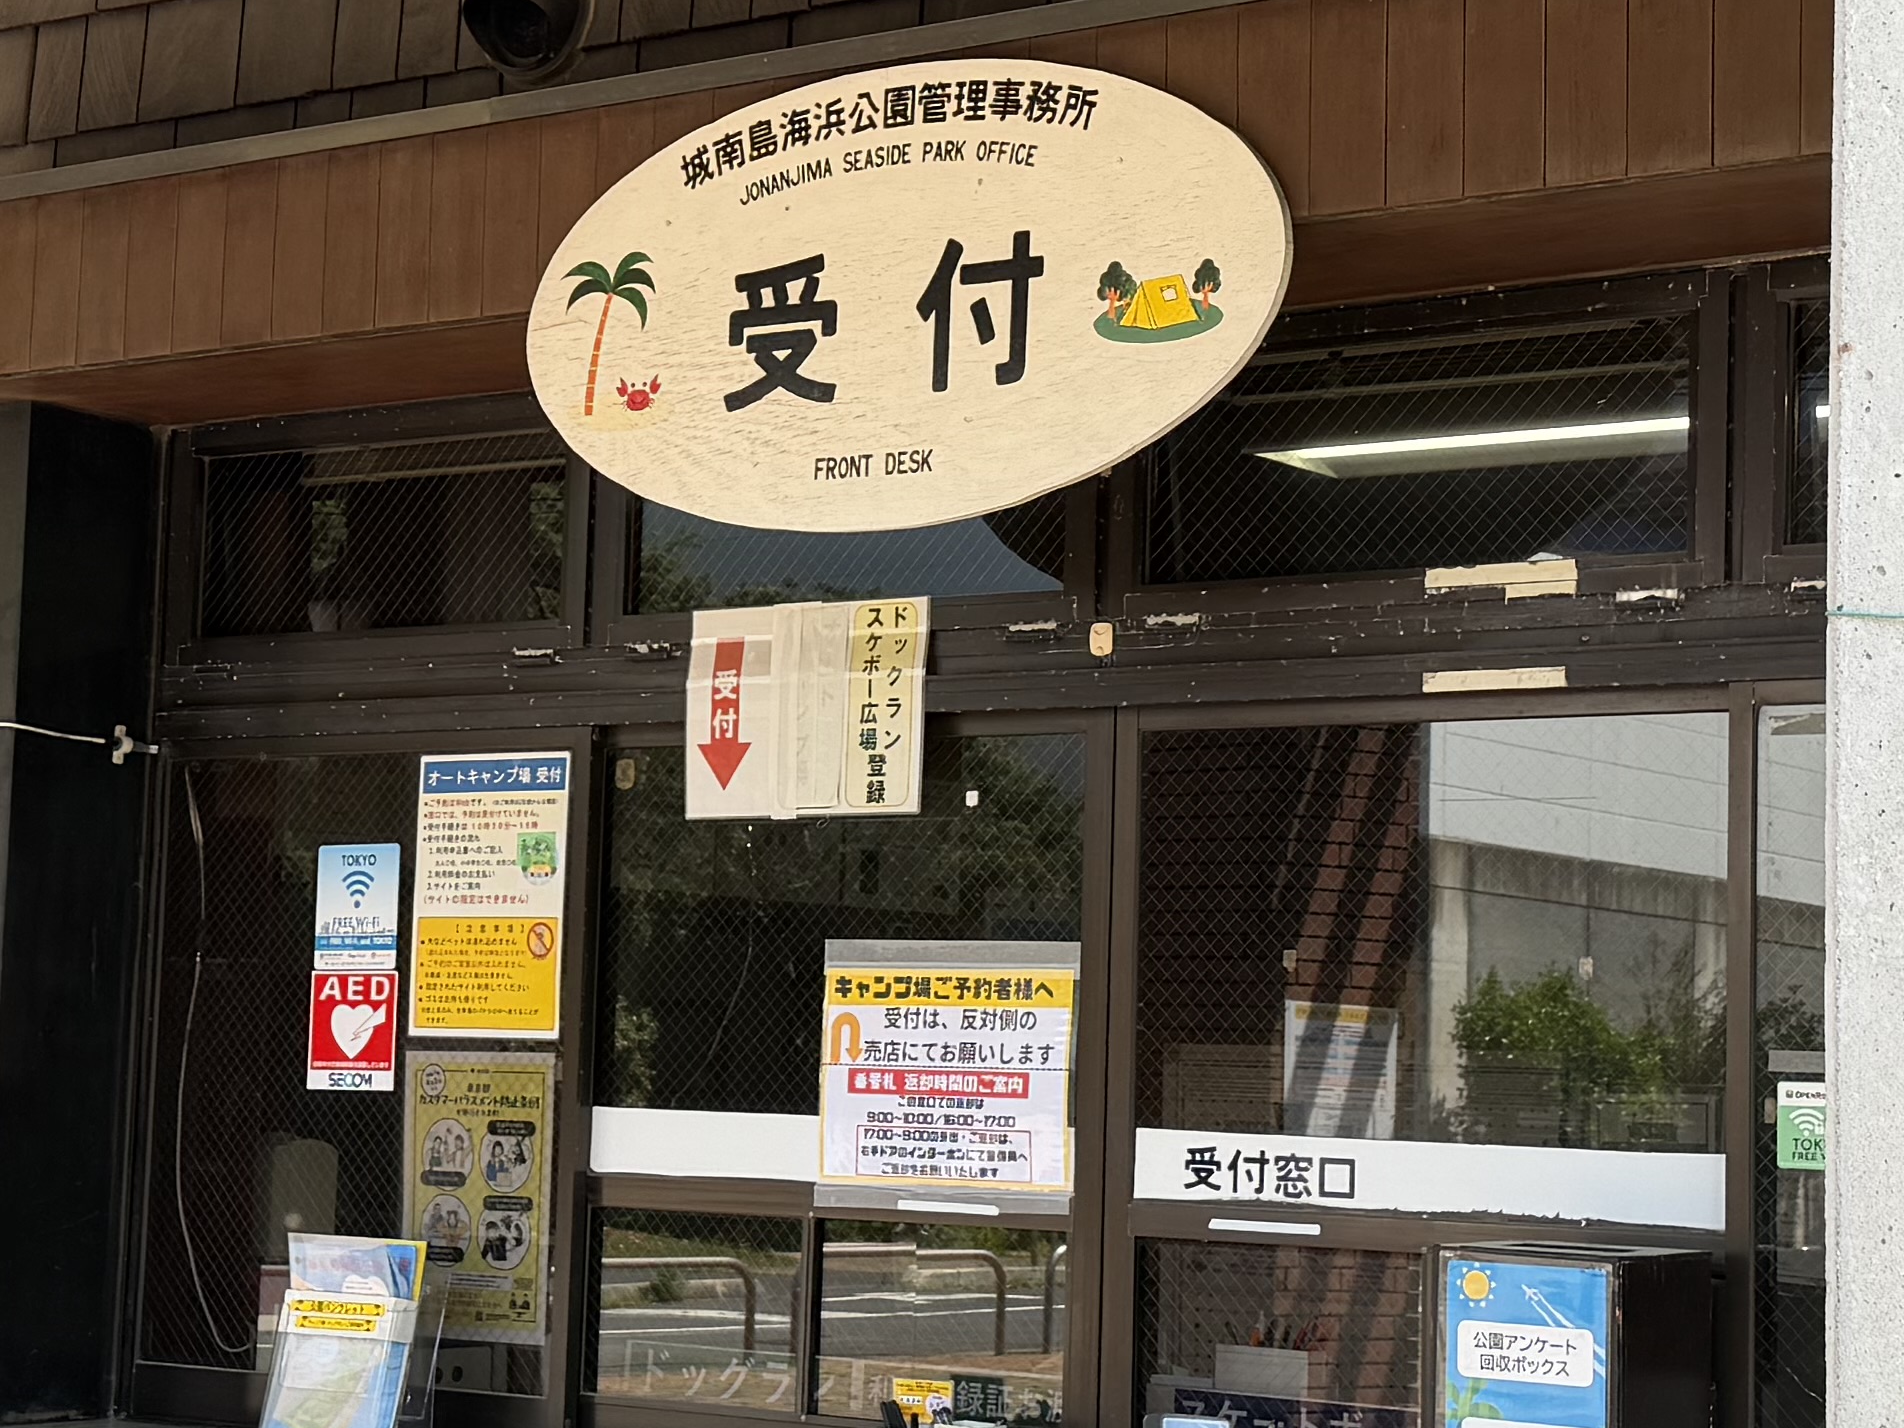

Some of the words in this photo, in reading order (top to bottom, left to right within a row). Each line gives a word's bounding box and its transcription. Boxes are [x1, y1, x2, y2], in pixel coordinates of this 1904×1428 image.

[679, 80, 1099, 189] 城南島海浜公園管理事務所
[739, 163, 833, 205] JONANJIMA
[843, 144, 912, 173] SEASIDE
[922, 142, 965, 165] PARK
[976, 142, 1038, 168] OFFICE
[814, 454, 872, 481] FRONT
[884, 449, 933, 476] DESK
[883, 606, 907, 749] ドックラン
[712, 669, 738, 739] 受付
[427, 766, 531, 786] オートキャンプ場
[536, 766, 561, 783] 受付
[342, 854, 376, 866] TOKYO
[333, 917, 353, 928] FREE
[355, 917, 379, 928] Wi-Fi
[318, 976, 391, 1001] AED
[834, 976, 1054, 1001] キャンプ場ご予約者様へ
[884, 1007, 1037, 1031] 受付は、反対側の
[863, 1040, 1055, 1066] 売店にてお願いします
[328, 1072, 373, 1088] SECOM
[854, 1072, 897, 1090] 番号札
[903, 1072, 1024, 1094] 返却時間のご案内
[1792, 1152, 1817, 1160] FREE
[1183, 1145, 1356, 1199] 受付窓口
[1473, 1331, 1577, 1355] 公園アンケート
[1480, 1354, 1570, 1377] 回収ボックス
